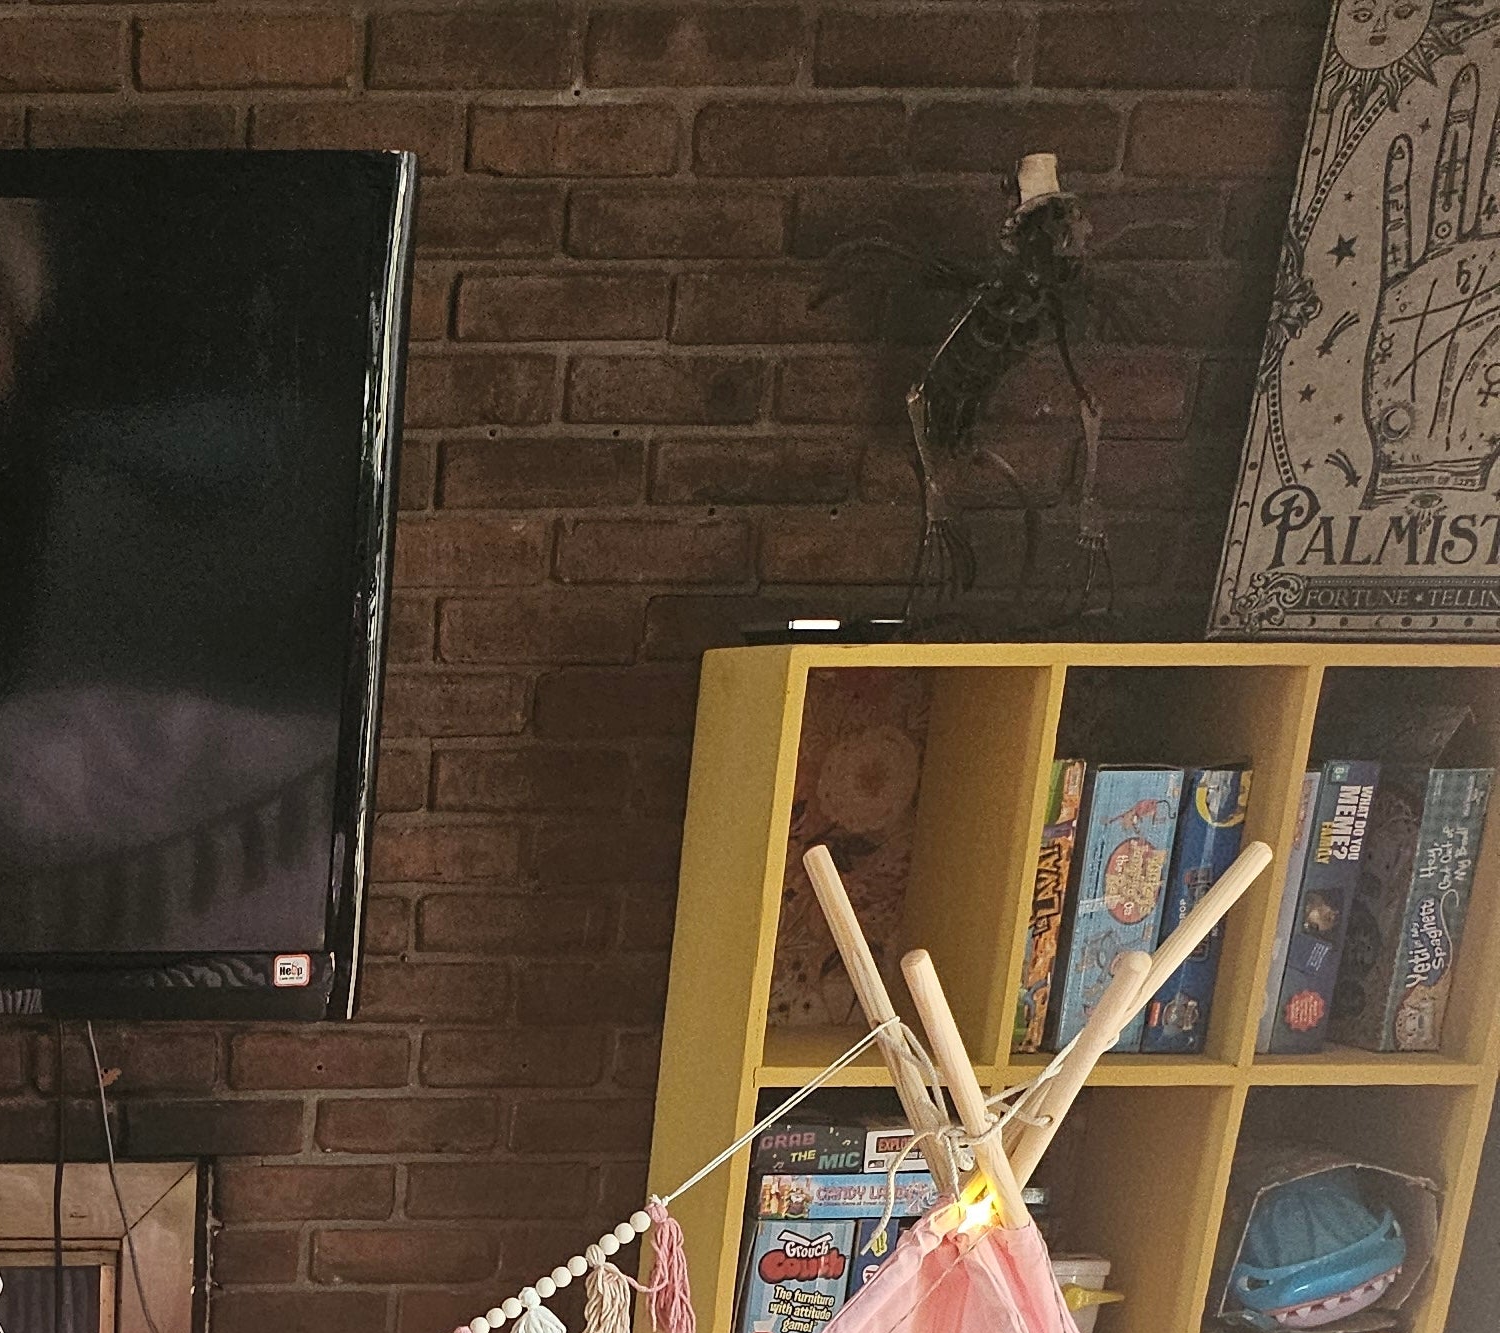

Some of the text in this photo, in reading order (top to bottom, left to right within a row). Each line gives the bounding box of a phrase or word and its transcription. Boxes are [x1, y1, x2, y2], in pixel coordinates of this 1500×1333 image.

[1304, 589, 1410, 607] FORTUNE
[1331, 785, 1362, 860] MEME?
[1347, 785, 1374, 861] WHAT DO YOU
[1315, 821, 1334, 865] FAMILY
[1033, 843, 1062, 919] LAVA!
[1405, 948, 1431, 989] Yeti
[760, 1132, 817, 1150] GRAB
[790, 1149, 817, 1163] THE
[817, 1151, 861, 1170] MIC
[816, 1185, 907, 1201] CANDY LAD
[785, 1241, 830, 1258] Grouch
[758, 1247, 847, 1284] Couch
[774, 1285, 835, 1307] The furniture
[769, 1301, 832, 1321] with attitude
